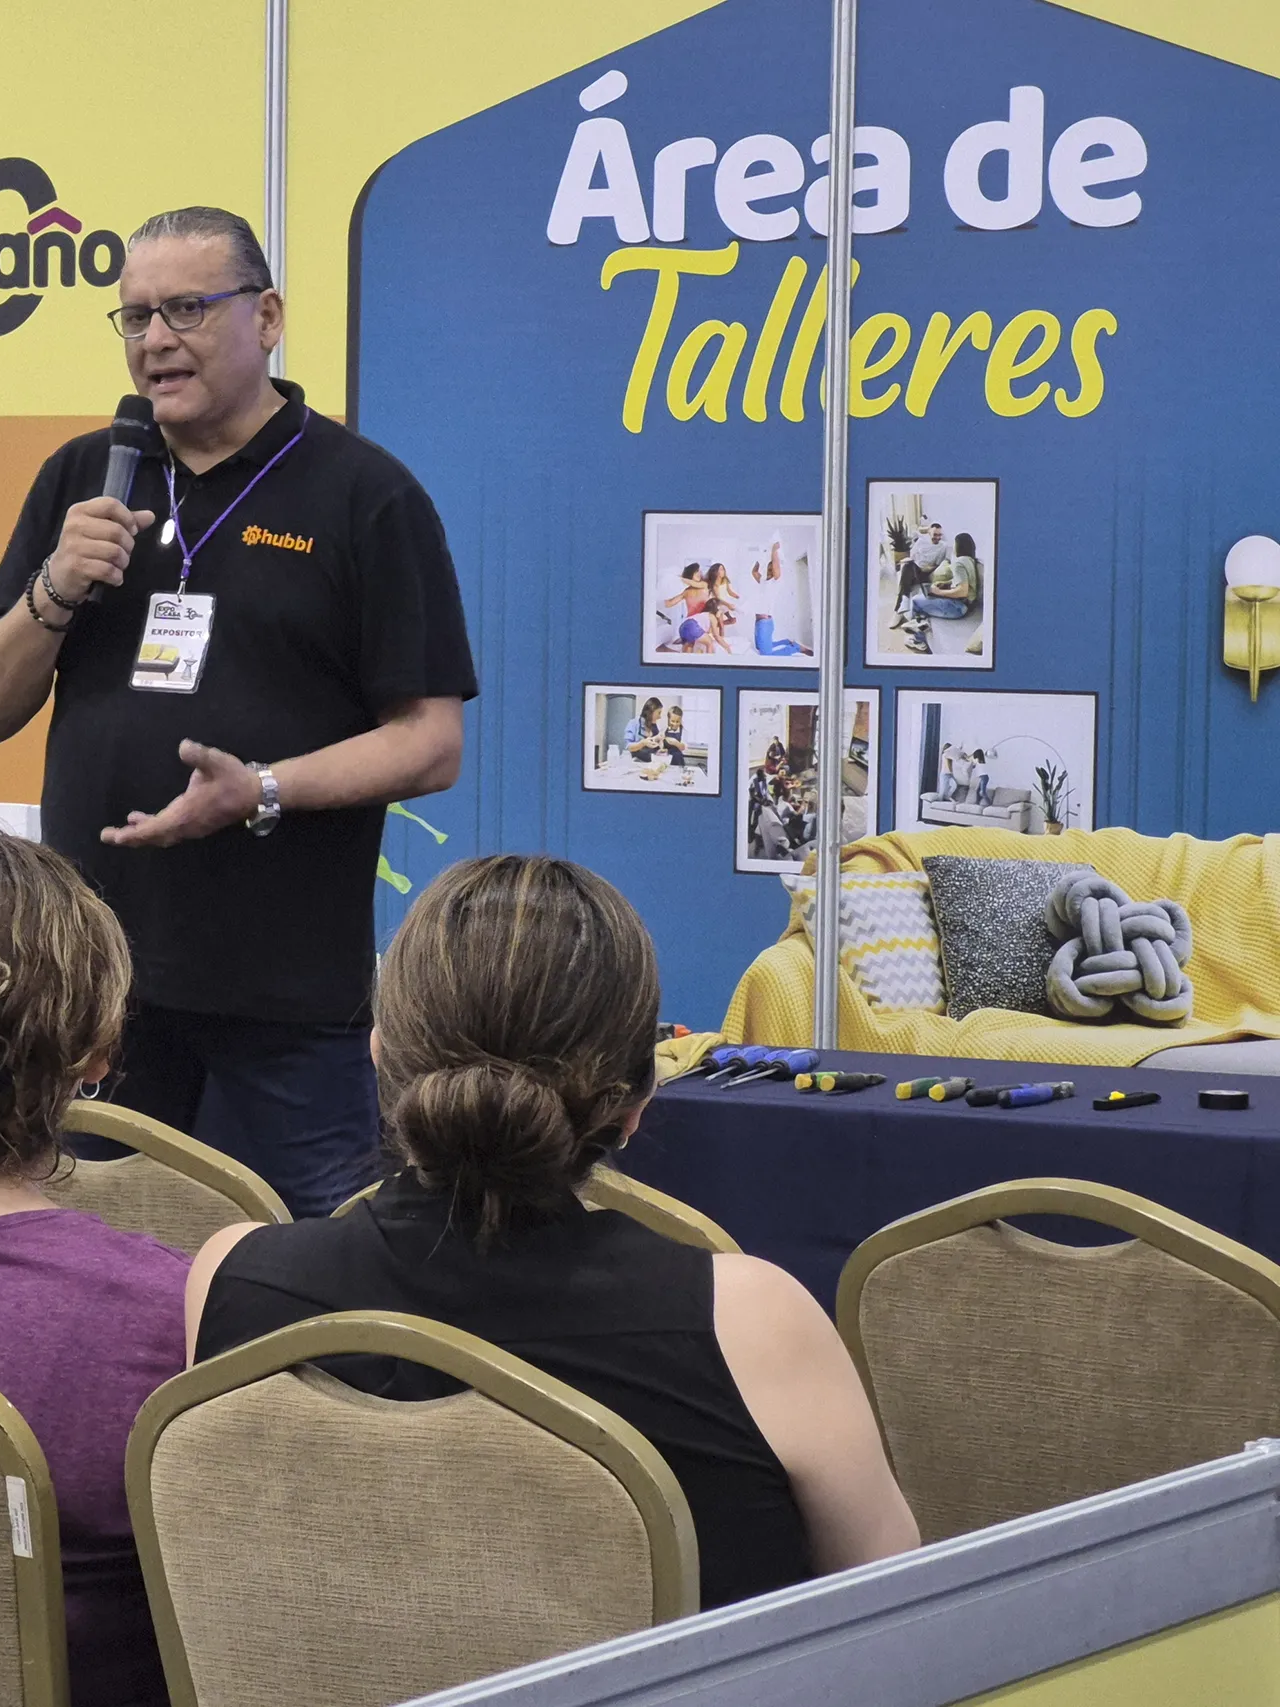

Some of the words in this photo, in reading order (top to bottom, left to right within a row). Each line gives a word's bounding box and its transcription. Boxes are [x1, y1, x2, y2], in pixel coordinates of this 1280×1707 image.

[547, 70, 911, 245] Área
[943, 86, 1148, 229] de
[601, 241, 1118, 435] Talleres
